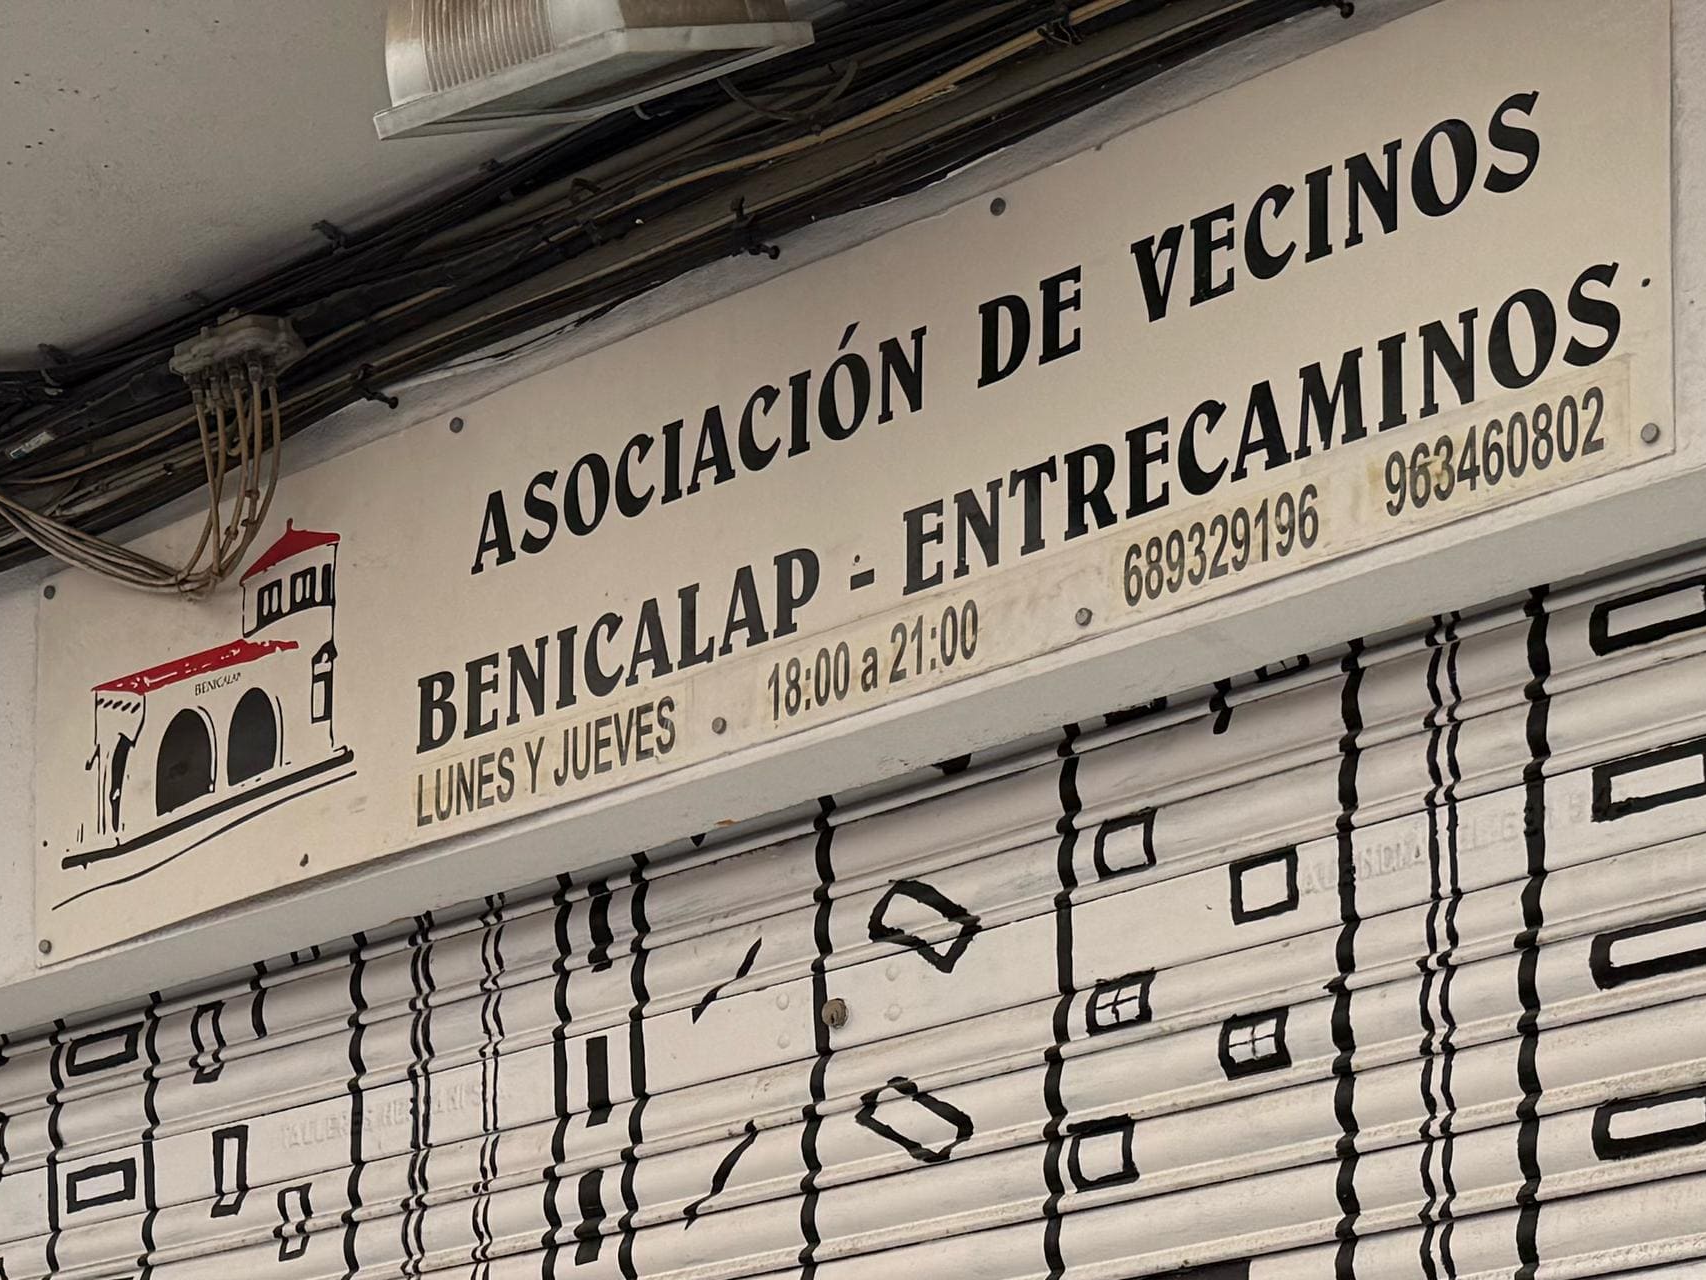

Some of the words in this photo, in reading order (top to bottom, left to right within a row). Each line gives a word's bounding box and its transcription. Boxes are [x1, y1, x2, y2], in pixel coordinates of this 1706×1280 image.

[416, 547, 820, 754] BENICALAP
[903, 262, 1621, 596] ENTRECAMINOS
[470, 324, 927, 576] ASOCIACIÓN
[977, 264, 1082, 389] DE
[1130, 90, 1540, 323] VECINOS
[416, 747, 515, 827] LUNES
[524, 737, 545, 794] Y
[553, 696, 676, 787] JUEVES
[767, 641, 851, 721] 18:00
[860, 645, 878, 693] a
[889, 600, 979, 684] 21:00
[1122, 483, 1319, 608] 689329196
[1384, 386, 1605, 517] 963460802
